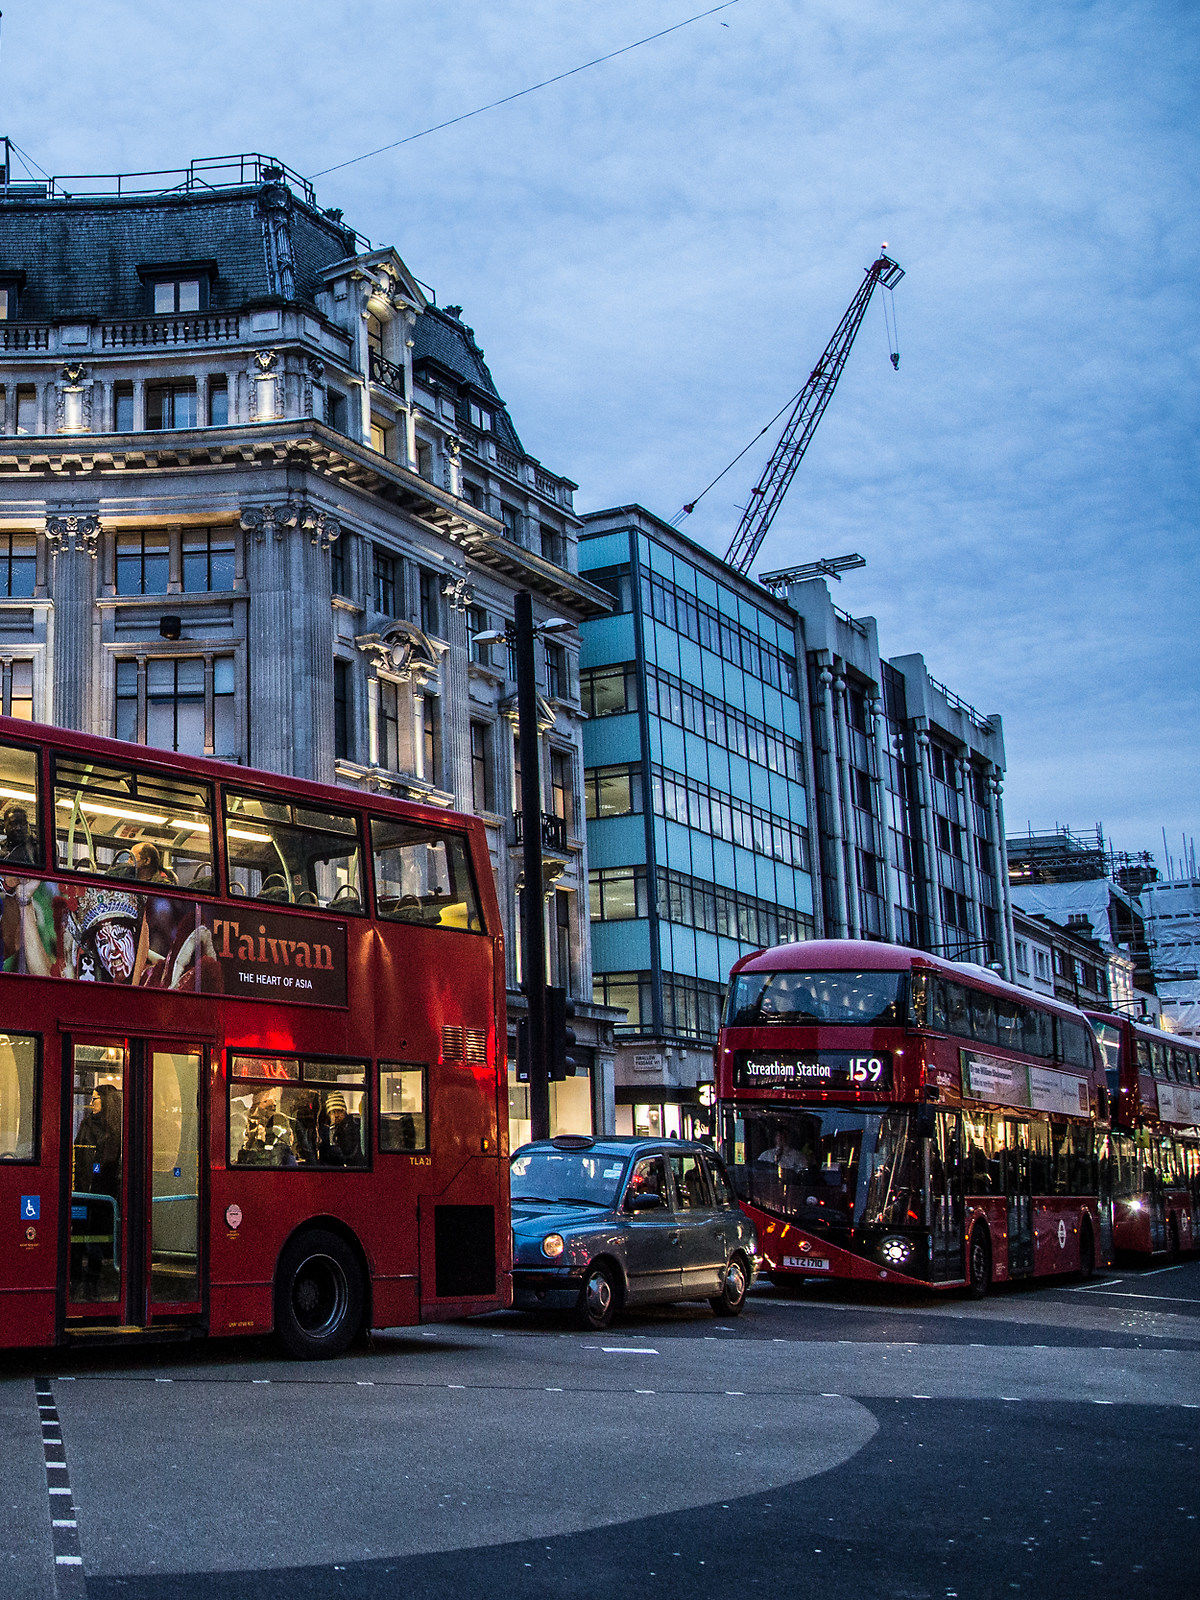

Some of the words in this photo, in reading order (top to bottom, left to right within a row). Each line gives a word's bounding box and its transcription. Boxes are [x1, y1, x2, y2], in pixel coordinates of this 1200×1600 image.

[213, 919, 335, 970] Taiwan
[238, 972, 254, 983] THE
[256, 974, 281, 986] HEART
[283, 977, 294, 987] OF
[295, 979, 313, 990] ASIA
[746, 1060, 794, 1075] Streatham
[796, 1061, 831, 1077] Station
[849, 1058, 882, 1082] 159
